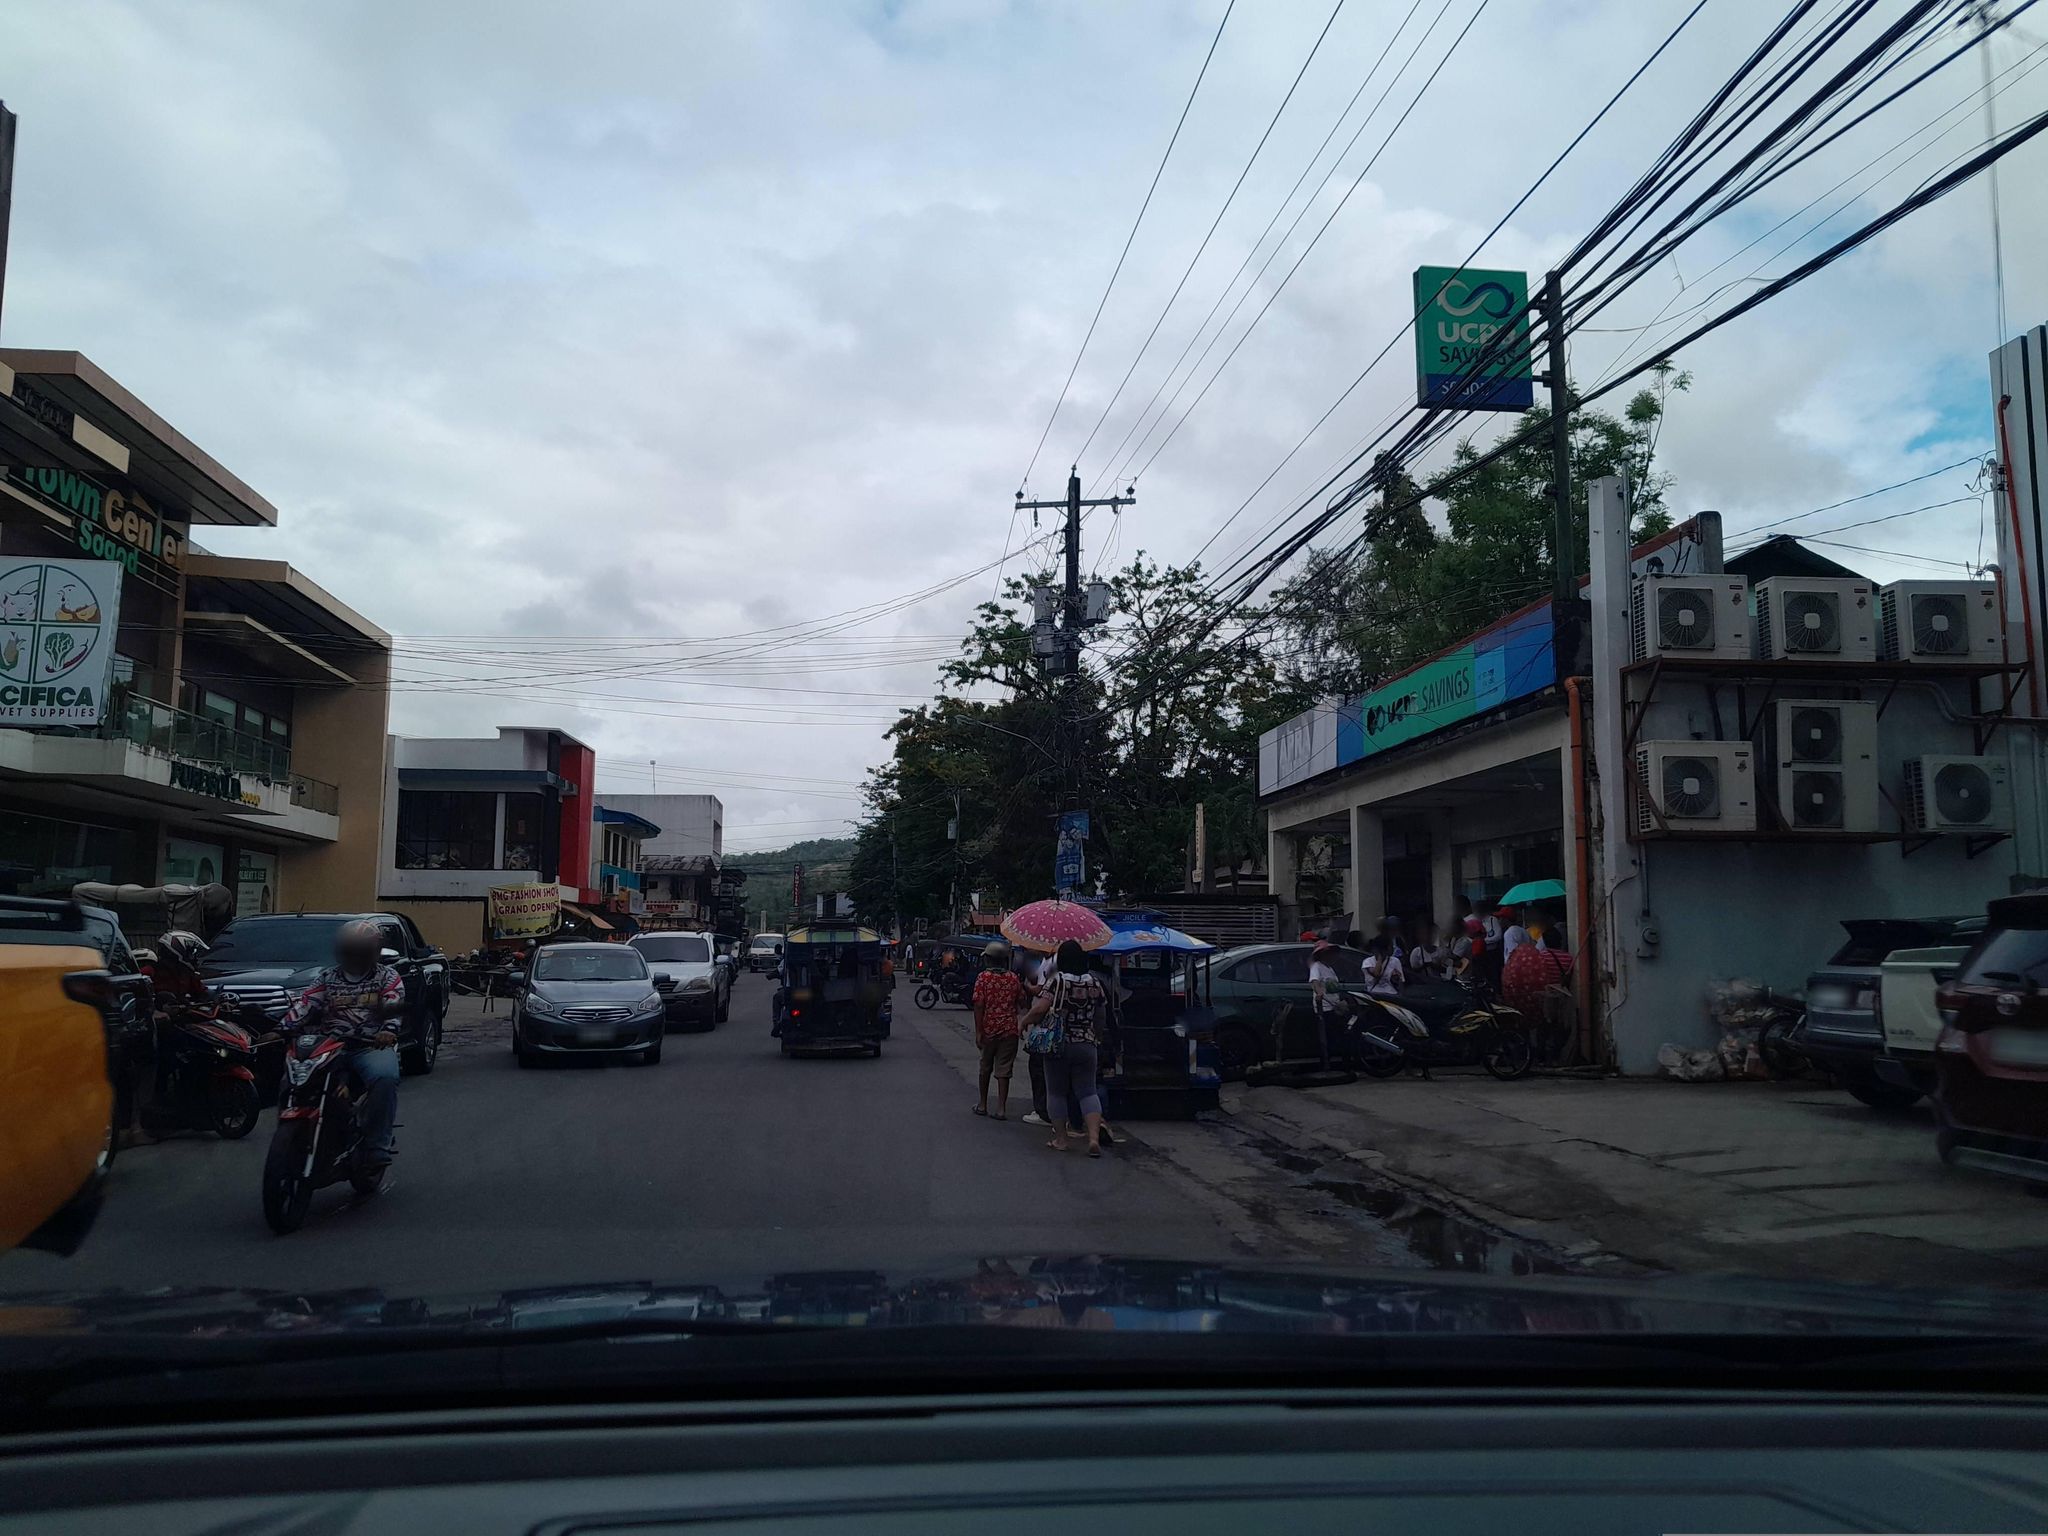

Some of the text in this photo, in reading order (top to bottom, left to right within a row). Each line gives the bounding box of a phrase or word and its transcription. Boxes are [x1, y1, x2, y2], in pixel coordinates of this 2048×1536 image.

[1422, 666, 1470, 711] SAVINGS
[0, 685, 94, 707] CIFICA
[31, 707, 95, 718] SUPPLIES
[510, 888, 542, 900] FASHION
[499, 904, 529, 915] GRAND
